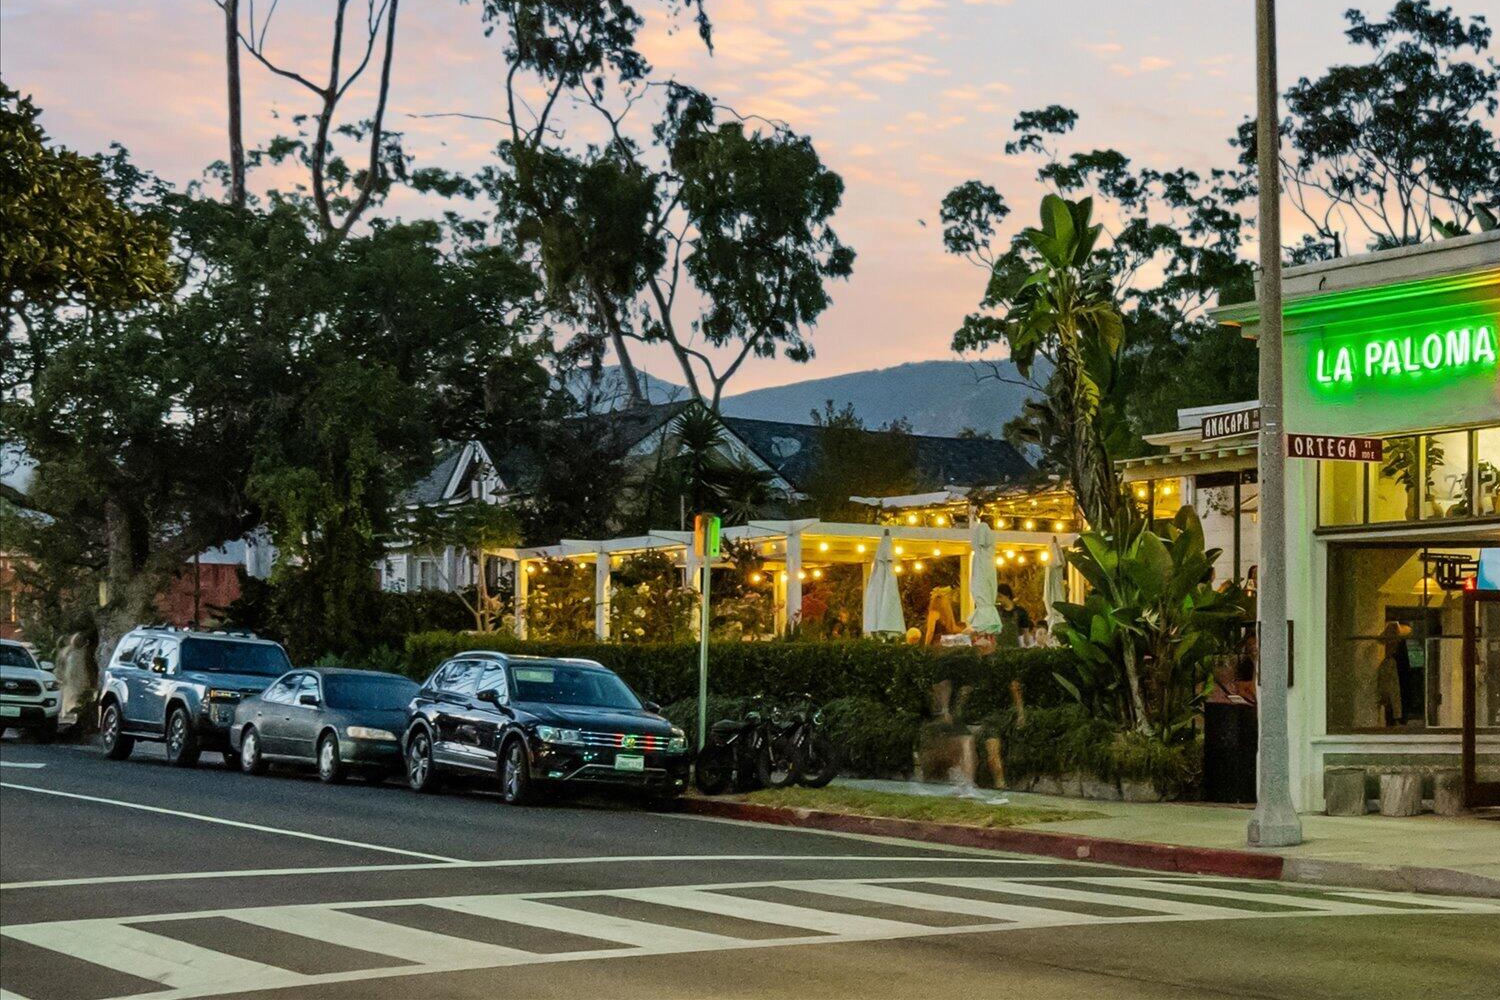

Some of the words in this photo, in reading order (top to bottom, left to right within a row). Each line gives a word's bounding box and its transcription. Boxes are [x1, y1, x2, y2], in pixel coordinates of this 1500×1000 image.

[1315, 347, 1353, 383] LA
[1365, 326, 1496, 377] PALOMA
[1205, 411, 1250, 437] ANACAPA
[1294, 436, 1356, 458] ORTEGA
